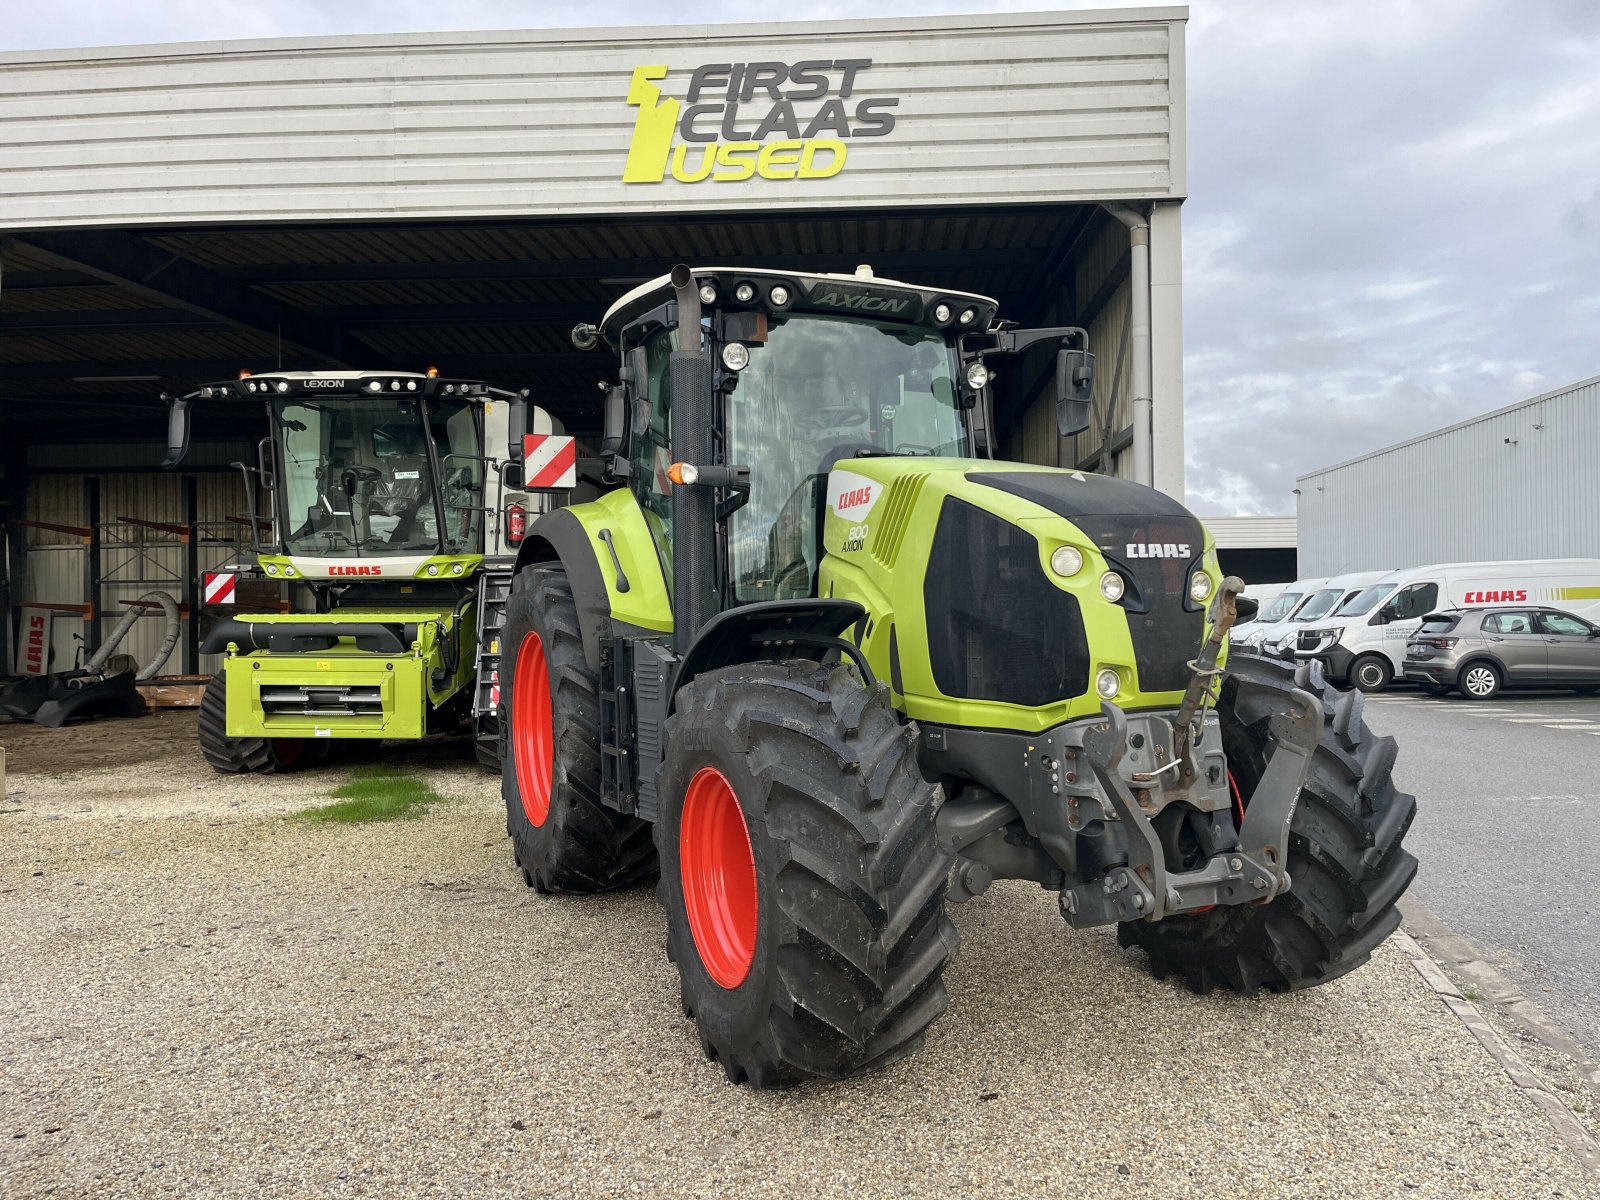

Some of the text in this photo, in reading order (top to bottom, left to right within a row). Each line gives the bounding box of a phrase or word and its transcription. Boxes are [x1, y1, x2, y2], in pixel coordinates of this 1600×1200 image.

[686, 58, 872, 102] FIRST
[680, 97, 900, 142] CLAAS
[671, 139, 847, 182] USED
[813, 292, 909, 313] AXION
[303, 379, 345, 388] LEXION
[838, 486, 871, 510] CLAAS
[848, 524, 869, 541] 800
[841, 539, 864, 553] AXION
[1126, 543, 1191, 559] CLAAS
[328, 565, 382, 576] CLAAS
[1464, 589, 1527, 604] CLAAS
[26, 615, 45, 674] LAAS
